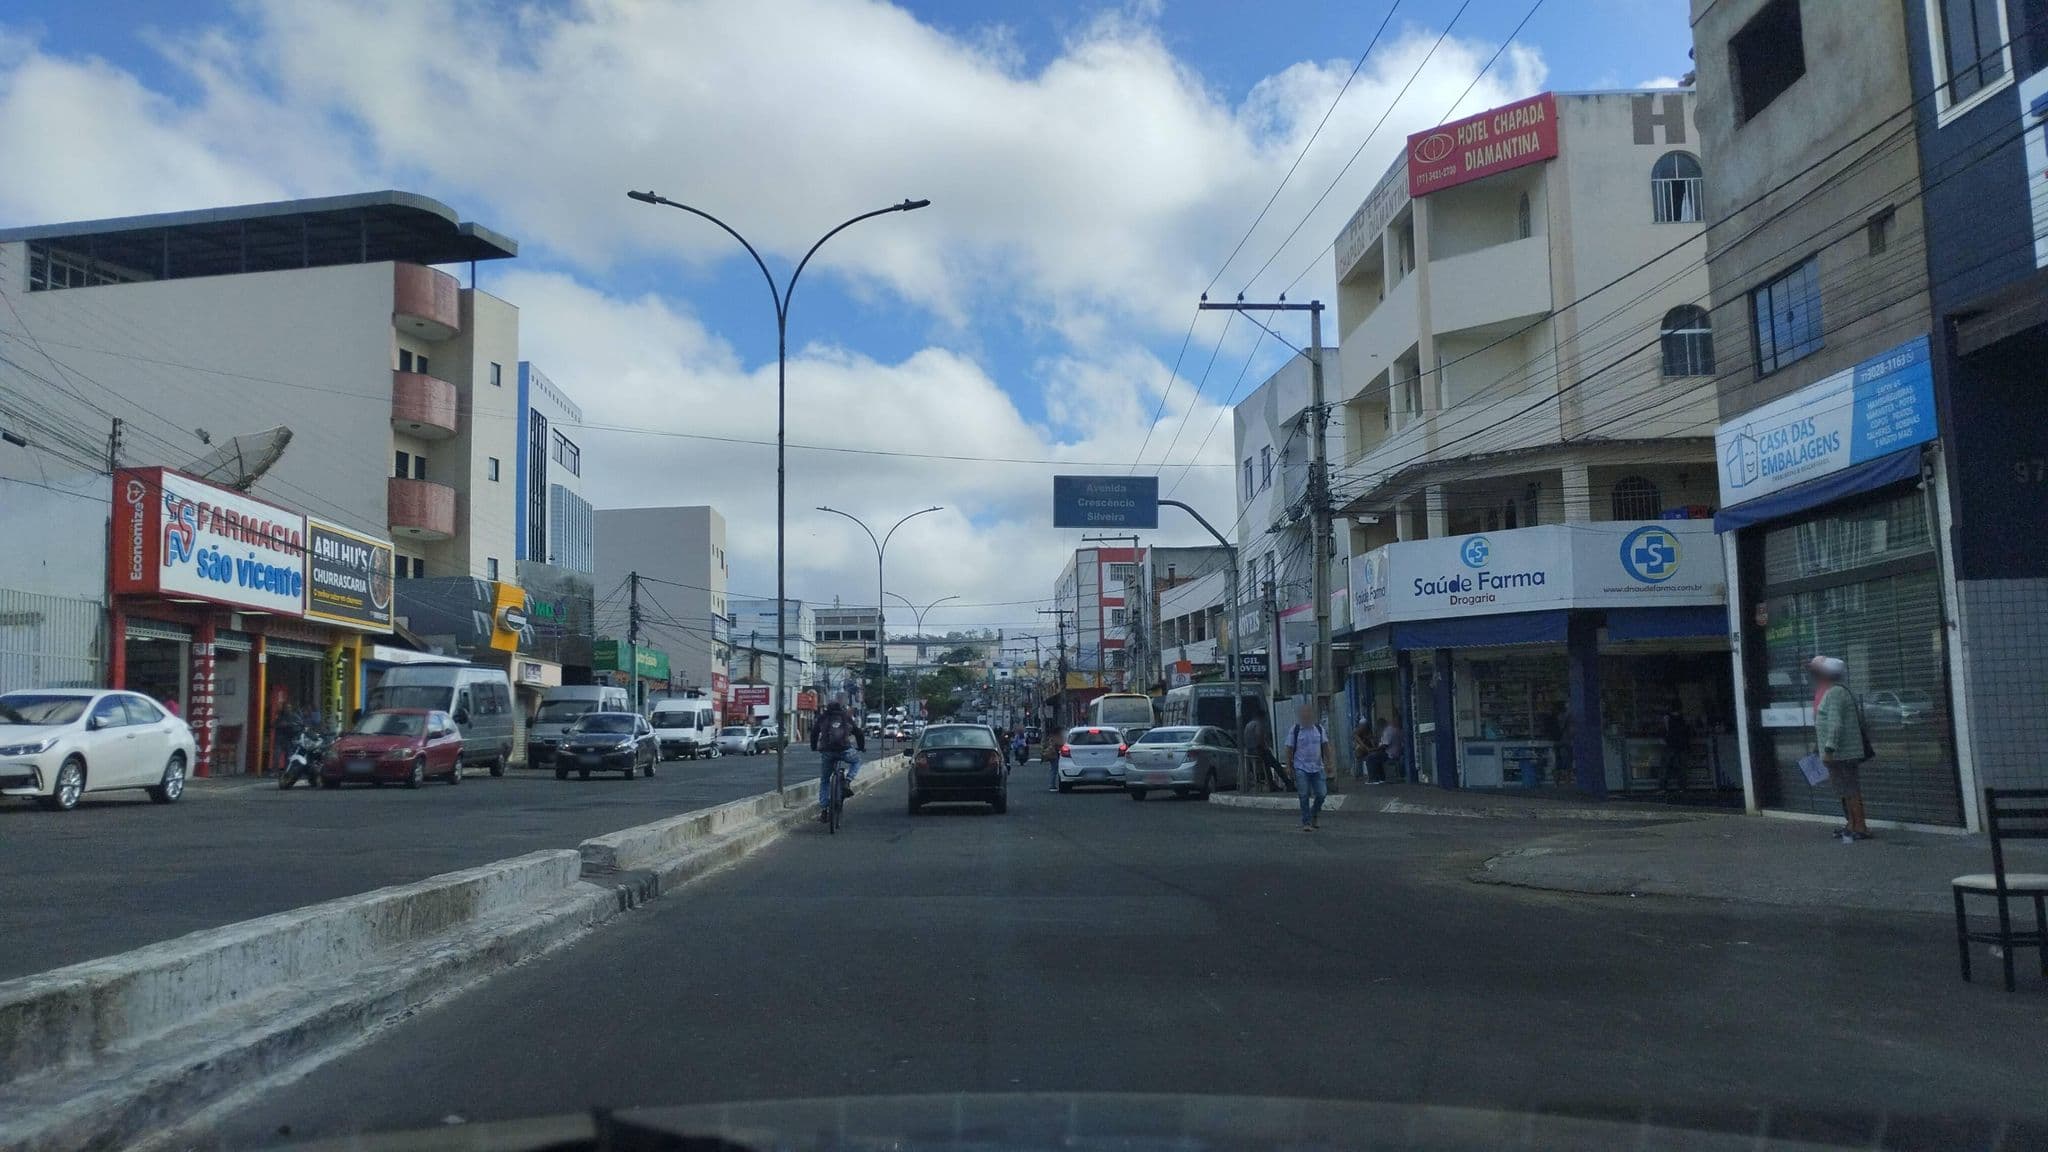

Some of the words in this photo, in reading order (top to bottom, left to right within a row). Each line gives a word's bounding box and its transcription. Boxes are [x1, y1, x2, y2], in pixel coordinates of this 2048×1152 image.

[1457, 119, 1489, 145] HOTEL
[1493, 102, 1545, 133] CHAPADA
[1465, 131, 1540, 172] DIAMANTINA
[1760, 428, 1789, 455] CASA
[1791, 416, 1816, 443] DAS
[1761, 430, 1840, 477] EMBALAGENS
[1086, 483, 1127, 493] Avenida
[197, 501, 302, 558] FARMÁCIA
[1087, 511, 1126, 521] Silveira
[131, 502, 144, 581] Economize
[314, 535, 368, 573] ABILHU'S
[197, 545, 233, 584] são
[236, 552, 302, 598] vicente
[313, 567, 367, 593] CHURRASCARIA
[1414, 573, 1472, 596] Saúde
[1478, 570, 1546, 590] Farma
[1450, 593, 1496, 606] Drogaria
[1232, 664, 1267, 673] ÓVEIS
